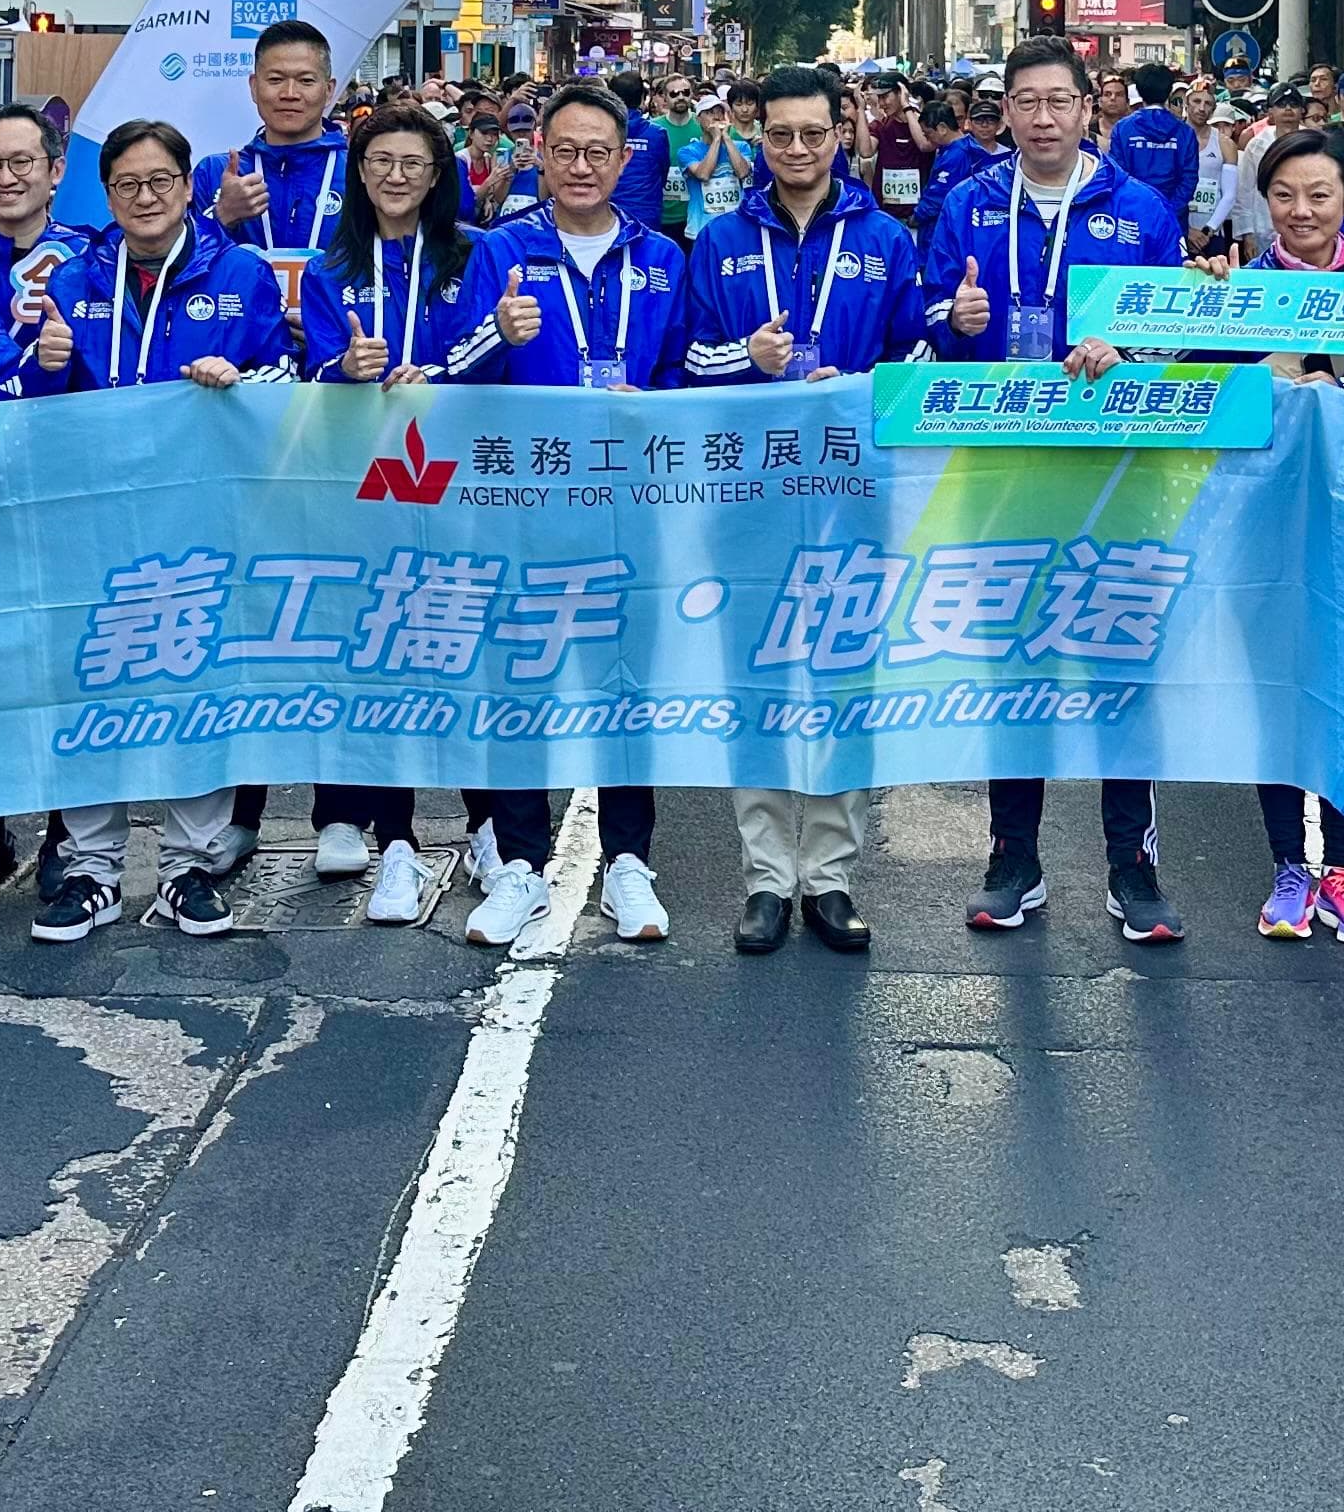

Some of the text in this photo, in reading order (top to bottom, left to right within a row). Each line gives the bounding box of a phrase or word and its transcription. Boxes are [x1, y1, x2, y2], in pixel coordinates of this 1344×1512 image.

[233, 1, 296, 13] POCARI
[135, 9, 211, 34] GARMIN
[233, 12, 290, 24] SWEAT
[192, 52, 254, 68] 中國移動
[192, 68, 221, 79] China
[883, 182, 919, 195] G1219
[705, 191, 741, 206] G3529
[1107, 321, 1137, 335] Join
[1140, 321, 1183, 336] hands
[1185, 323, 1216, 336] with
[1219, 323, 1295, 340] Volunteers,
[1299, 329, 1317, 341] we
[1319, 328, 1344, 341] run
[913, 419, 1206, 436] Join hands with Volunteers, we run further!
[471, 424, 861, 476] 義務工作發展局
[458, 475, 877, 509] AGENCY FOR VOLUNTEER SERVICE
[57, 681, 1139, 751] Join hands with Volunteers, we run further!
